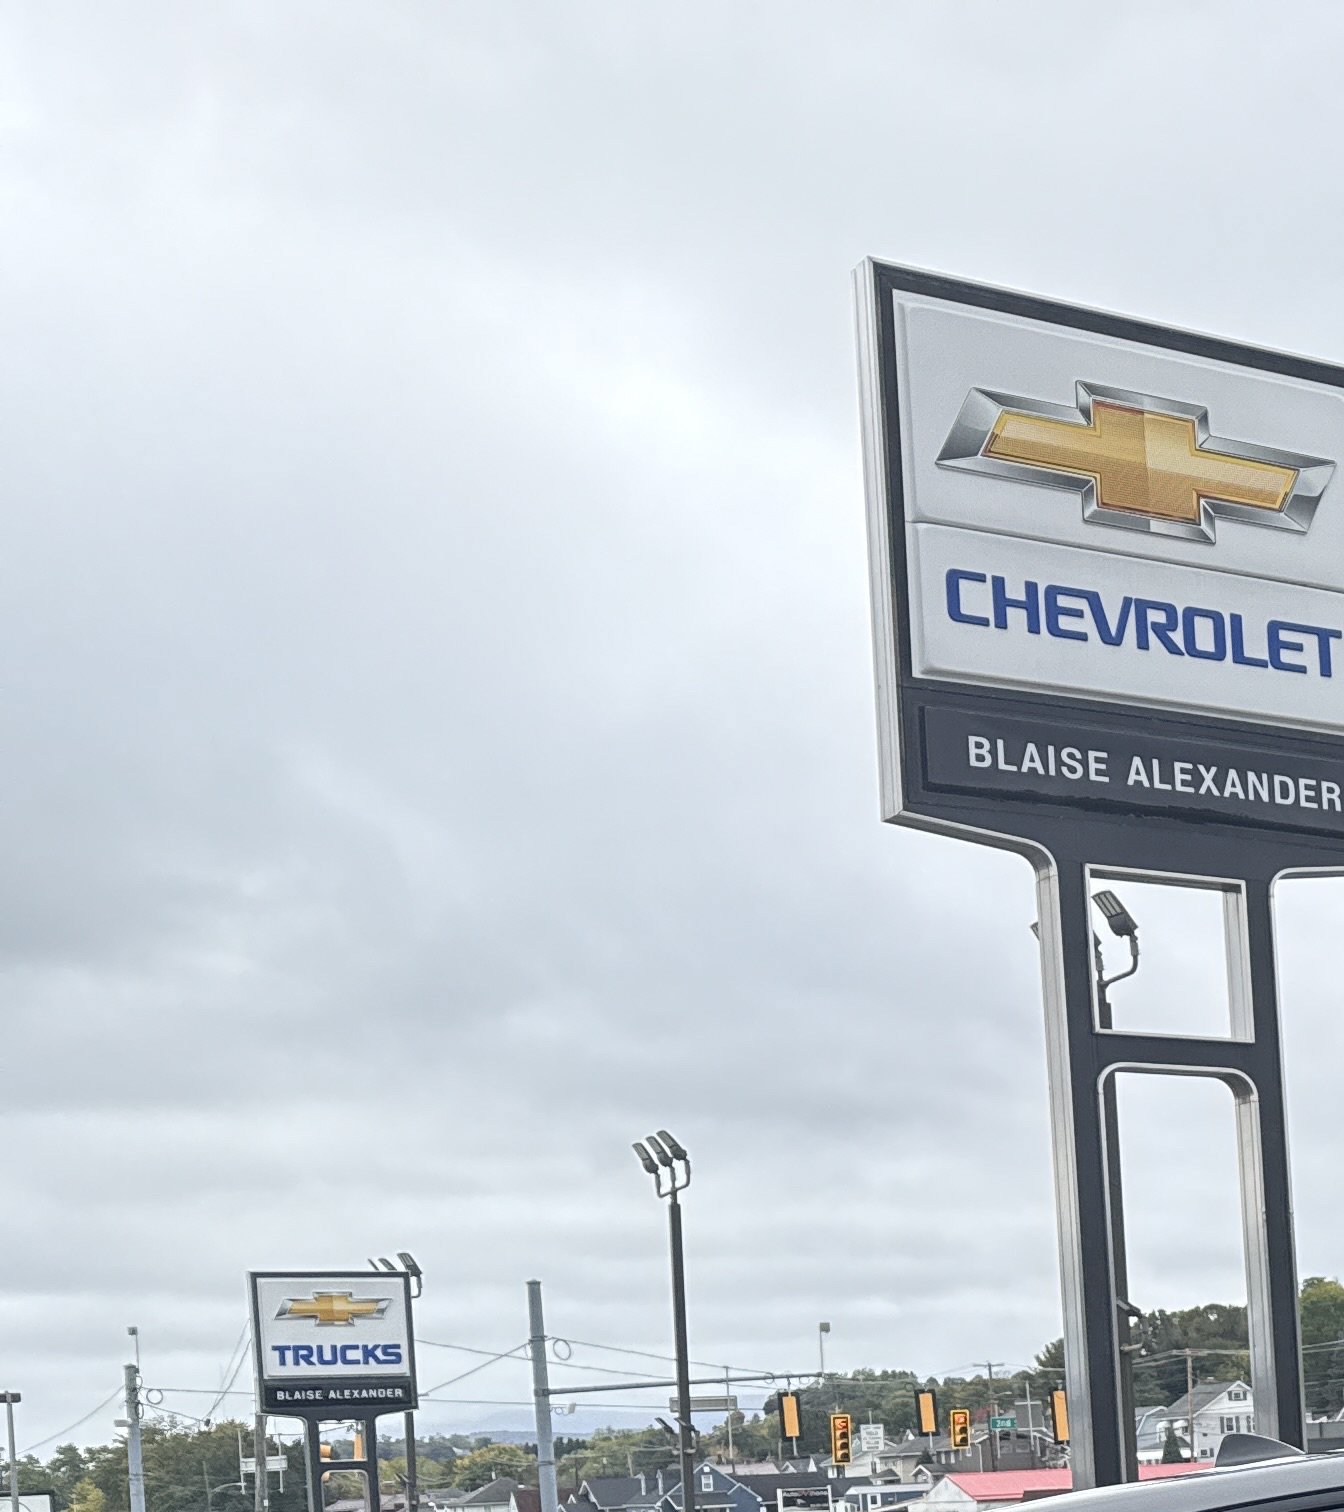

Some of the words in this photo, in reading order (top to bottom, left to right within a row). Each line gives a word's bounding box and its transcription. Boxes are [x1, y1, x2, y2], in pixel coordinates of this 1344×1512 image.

[945, 568, 1342, 677] CHEVROLET
[967, 734, 1110, 783] BLAISE
[1126, 755, 1342, 812] ALEXANDER
[271, 1343, 403, 1366] TRUCKS
[276, 1389, 324, 1401] BLAISE
[328, 1388, 403, 1400] ALEXANDER
